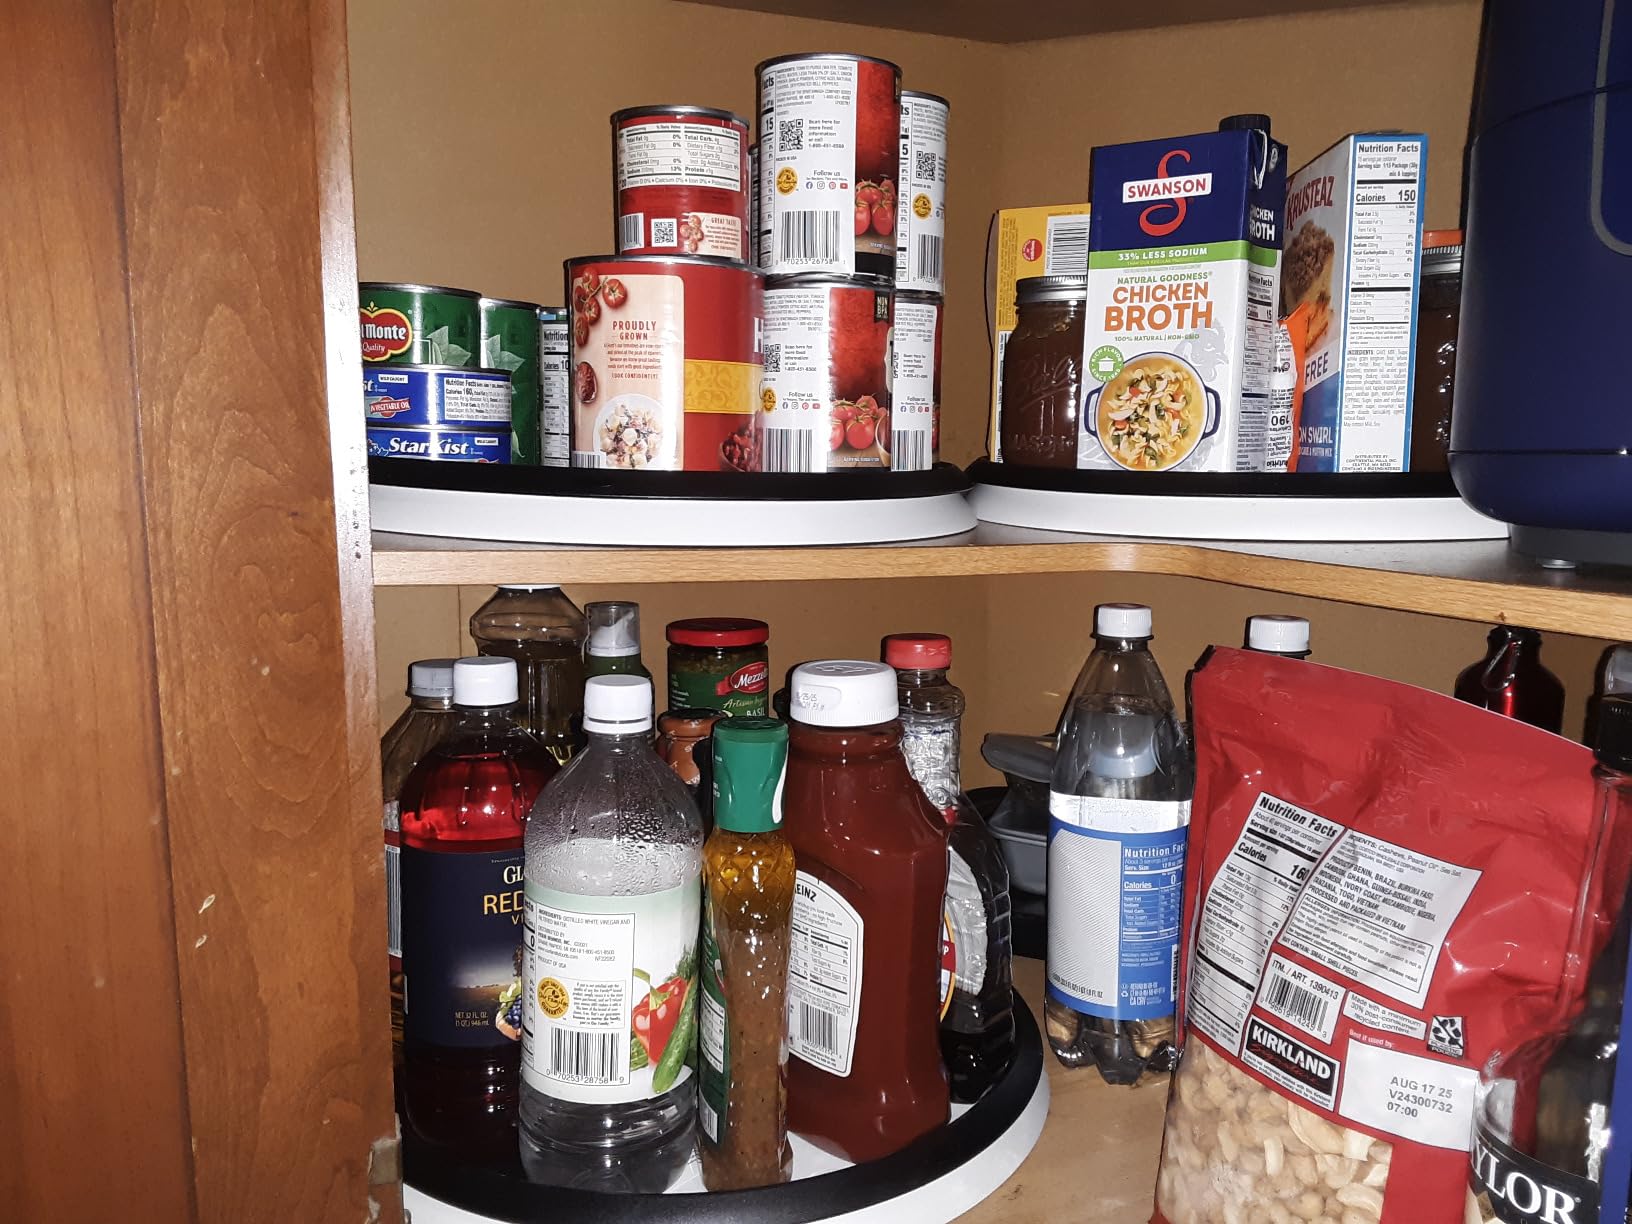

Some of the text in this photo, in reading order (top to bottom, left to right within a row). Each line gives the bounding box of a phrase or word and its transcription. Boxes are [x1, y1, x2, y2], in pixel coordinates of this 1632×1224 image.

[766, 117, 774, 131] 15
[902, 144, 910, 155] 5
[1358, 144, 1418, 153] Nutrition Facts
[1392, 162, 1408, 170] Package
[1127, 178, 1207, 199] SWANSON
[1356, 190, 1416, 203] Calories 150
[1286, 175, 1335, 231] KRUSTEAZ
[1118, 247, 1209, 261] 33% LESS SODIUM
[1117, 277, 1158, 285] NATURAL
[877, 297, 888, 306] NON
[1112, 282, 1209, 304] CHICKEN
[1104, 302, 1213, 331] BROTH
[366, 324, 407, 341] Monte
[612, 320, 657, 331] PROUDLY
[363, 342, 386, 353] Quality
[1305, 352, 1329, 386] FREE
[445, 379, 464, 387] Nutrition
[1308, 427, 1334, 444] SWIRL
[388, 438, 469, 456] StarKist
[746, 707, 765, 717] BASIL
[1259, 796, 1338, 839] Nutrition Facts
[1250, 818, 1279, 837] Serving size
[1254, 811, 1322, 845] About servings per container
[1243, 833, 1260, 847] Amount
[1124, 843, 1185, 858] Nutrition Fac
[1238, 842, 1267, 863] Calories
[1359, 845, 1376, 857] COSTCO
[1226, 863, 1236, 874] Total
[1379, 844, 1449, 877] Cashews, Peanut Sea
[1124, 874, 1176, 890] Calories 0
[1347, 872, 1369, 888] GHANA,
[1353, 864, 1373, 881] BENIN,
[1374, 873, 1397, 890] BRAZIL,
[1398, 882, 1421, 898] BURKINA
[1211, 887, 1235, 905] Cholesterol
[1312, 876, 1337, 893] TANZANIA,
[1355, 896, 1379, 911] VIETNAM
[1344, 880, 1363, 895] IVORY
[1382, 897, 1416, 916] MOZAMBIQUE,
[1208, 896, 1222, 909] Sodium
[1305, 896, 1331, 912] ALLERGEN
[1308, 884, 1407, 932] PROCESSED AND PACKAGED VIETNAM
[563, 915, 583, 924] DISTILLED
[1213, 909, 1240, 928] Carbohydrate
[1310, 949, 1328, 963] SMALL
[1327, 957, 1344, 971] SHELL
[1330, 940, 1418, 982] allergies and food please read
[1272, 960, 1340, 1001] ITM. ART. 1390413
[455, 1012, 464, 1020] NET
[1350, 1003, 1418, 1031] 30% post-consumer
[1351, 993, 1368, 1006] Made
[1368, 1002, 1381, 1012] with
[1387, 1011, 1422, 1027] minimum
[471, 1019, 481, 1028] 946
[1293, 1014, 1317, 1032] 14245
[1354, 1013, 1381, 1027] recycled
[1349, 1028, 1362, 1038] Best
[1362, 1031, 1368, 1039] if
[1368, 1033, 1384, 1043] used
[1251, 1024, 1332, 1080] KIRKLAND
[557, 1073, 580, 1083] 70253
[1390, 1076, 1453, 1099] AUG 17 25
[1387, 1101, 1418, 1118] 07:00
[1389, 1088, 1453, 1114] V24300732
[1475, 1135, 1576, 1224] YLOR
